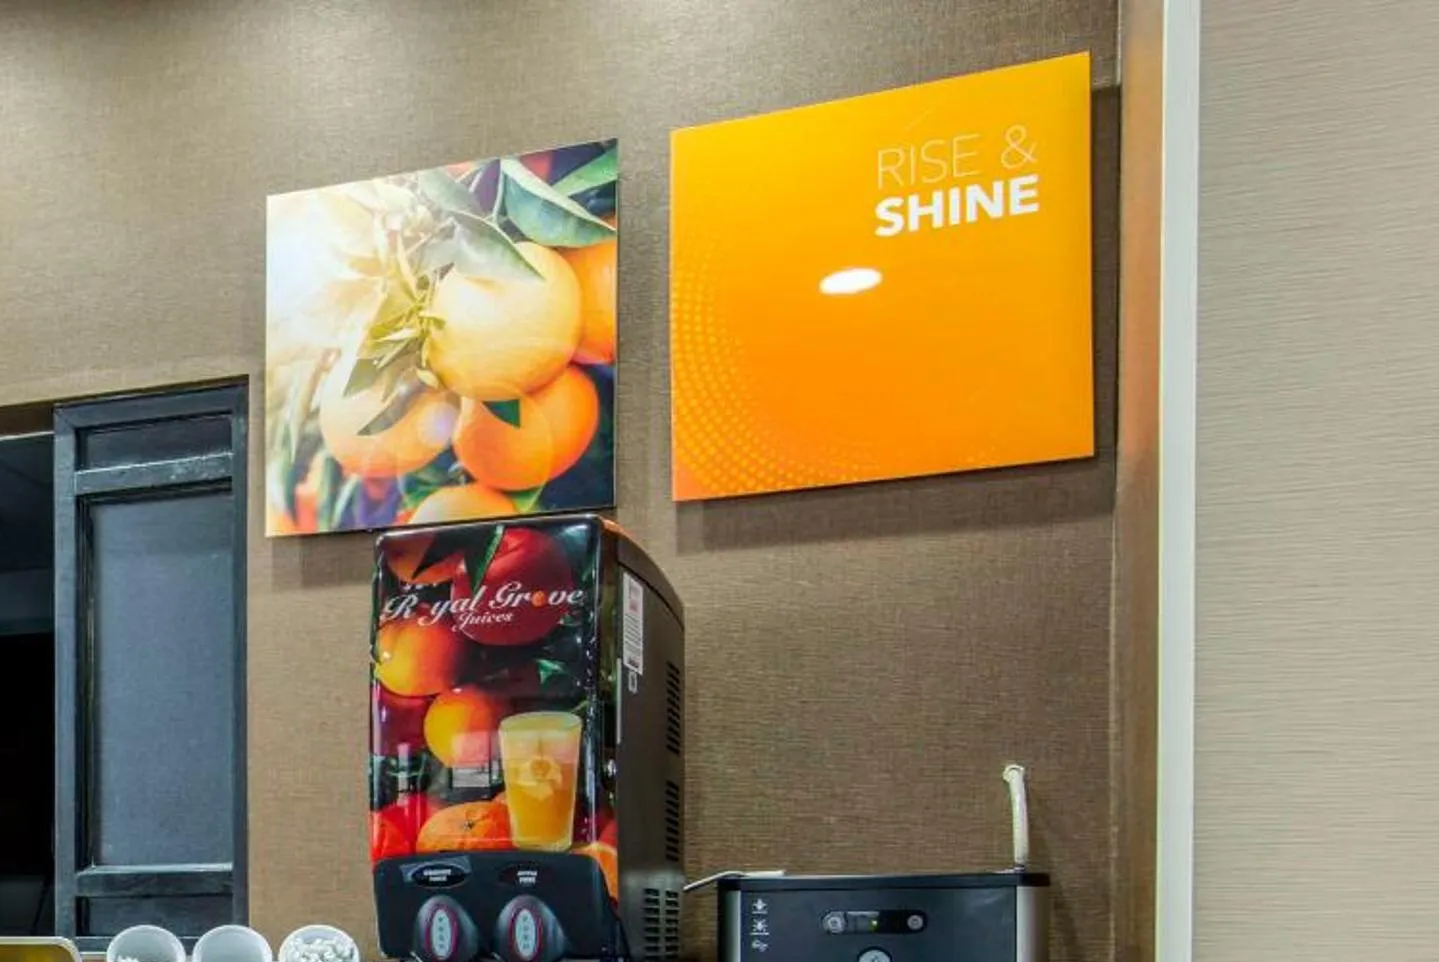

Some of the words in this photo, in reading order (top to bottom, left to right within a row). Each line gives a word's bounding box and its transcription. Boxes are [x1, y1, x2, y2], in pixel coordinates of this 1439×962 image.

[877, 133, 981, 190] RISE
[1000, 124, 1038, 170] &
[875, 174, 1040, 237] SHINE
[488, 580, 584, 609] Grove
[452, 612, 513, 632] Juices
